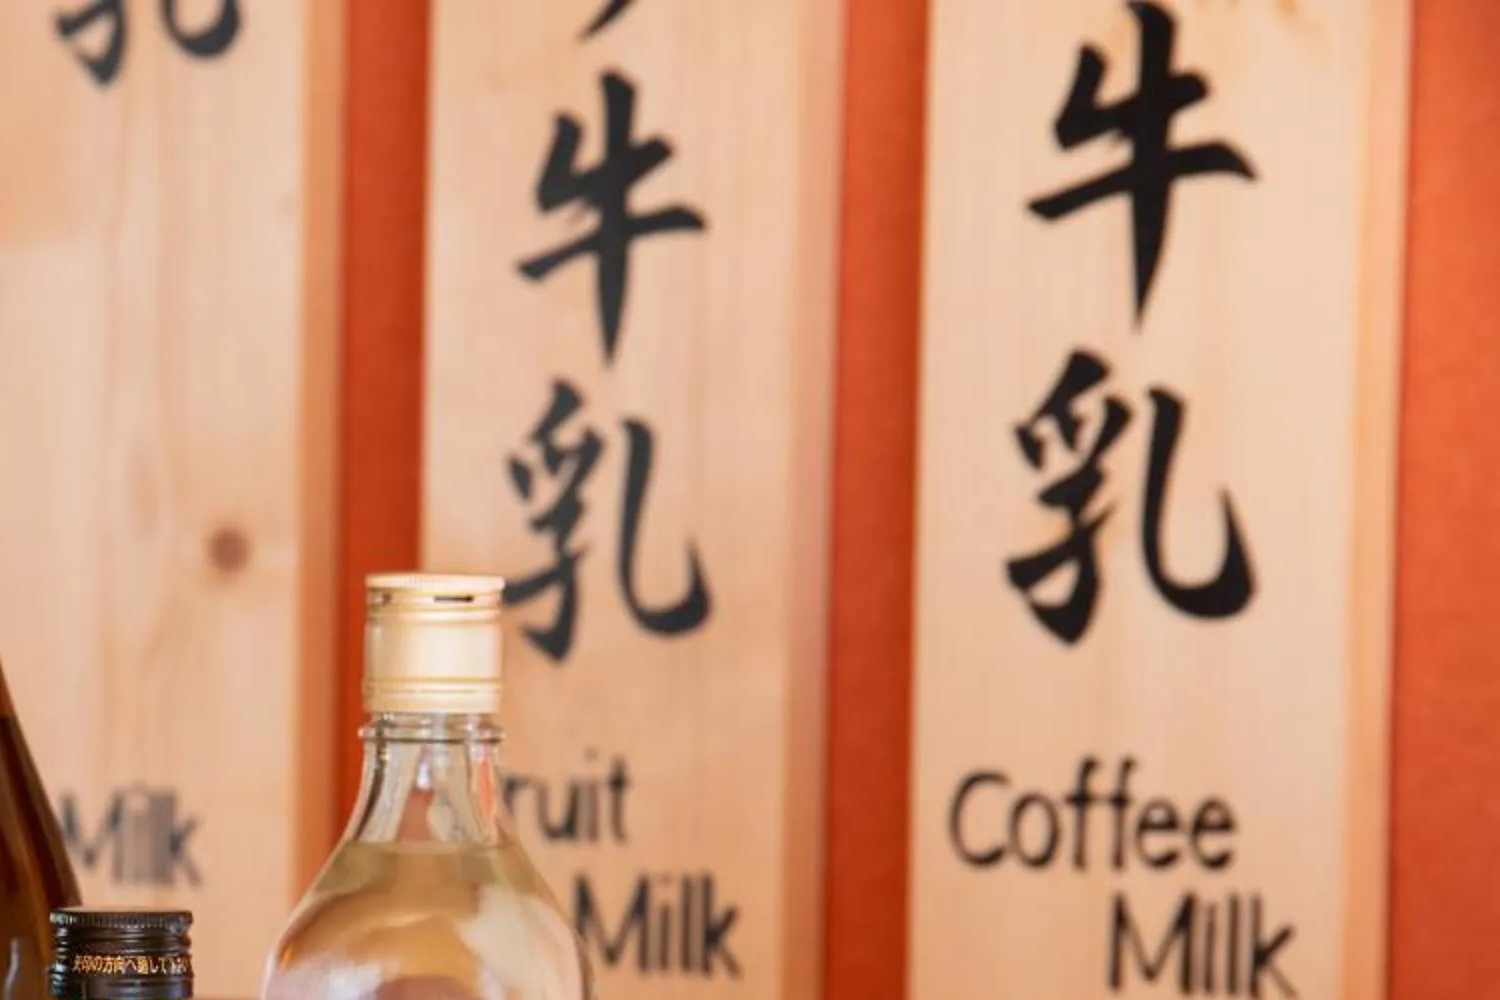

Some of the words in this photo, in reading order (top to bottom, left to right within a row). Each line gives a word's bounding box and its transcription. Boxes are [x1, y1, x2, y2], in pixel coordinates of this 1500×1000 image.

[501, 748, 630, 844] ruit
[948, 757, 1238, 868] Coffee
[574, 872, 743, 978] Milk
[1107, 893, 1300, 1000] Milk
